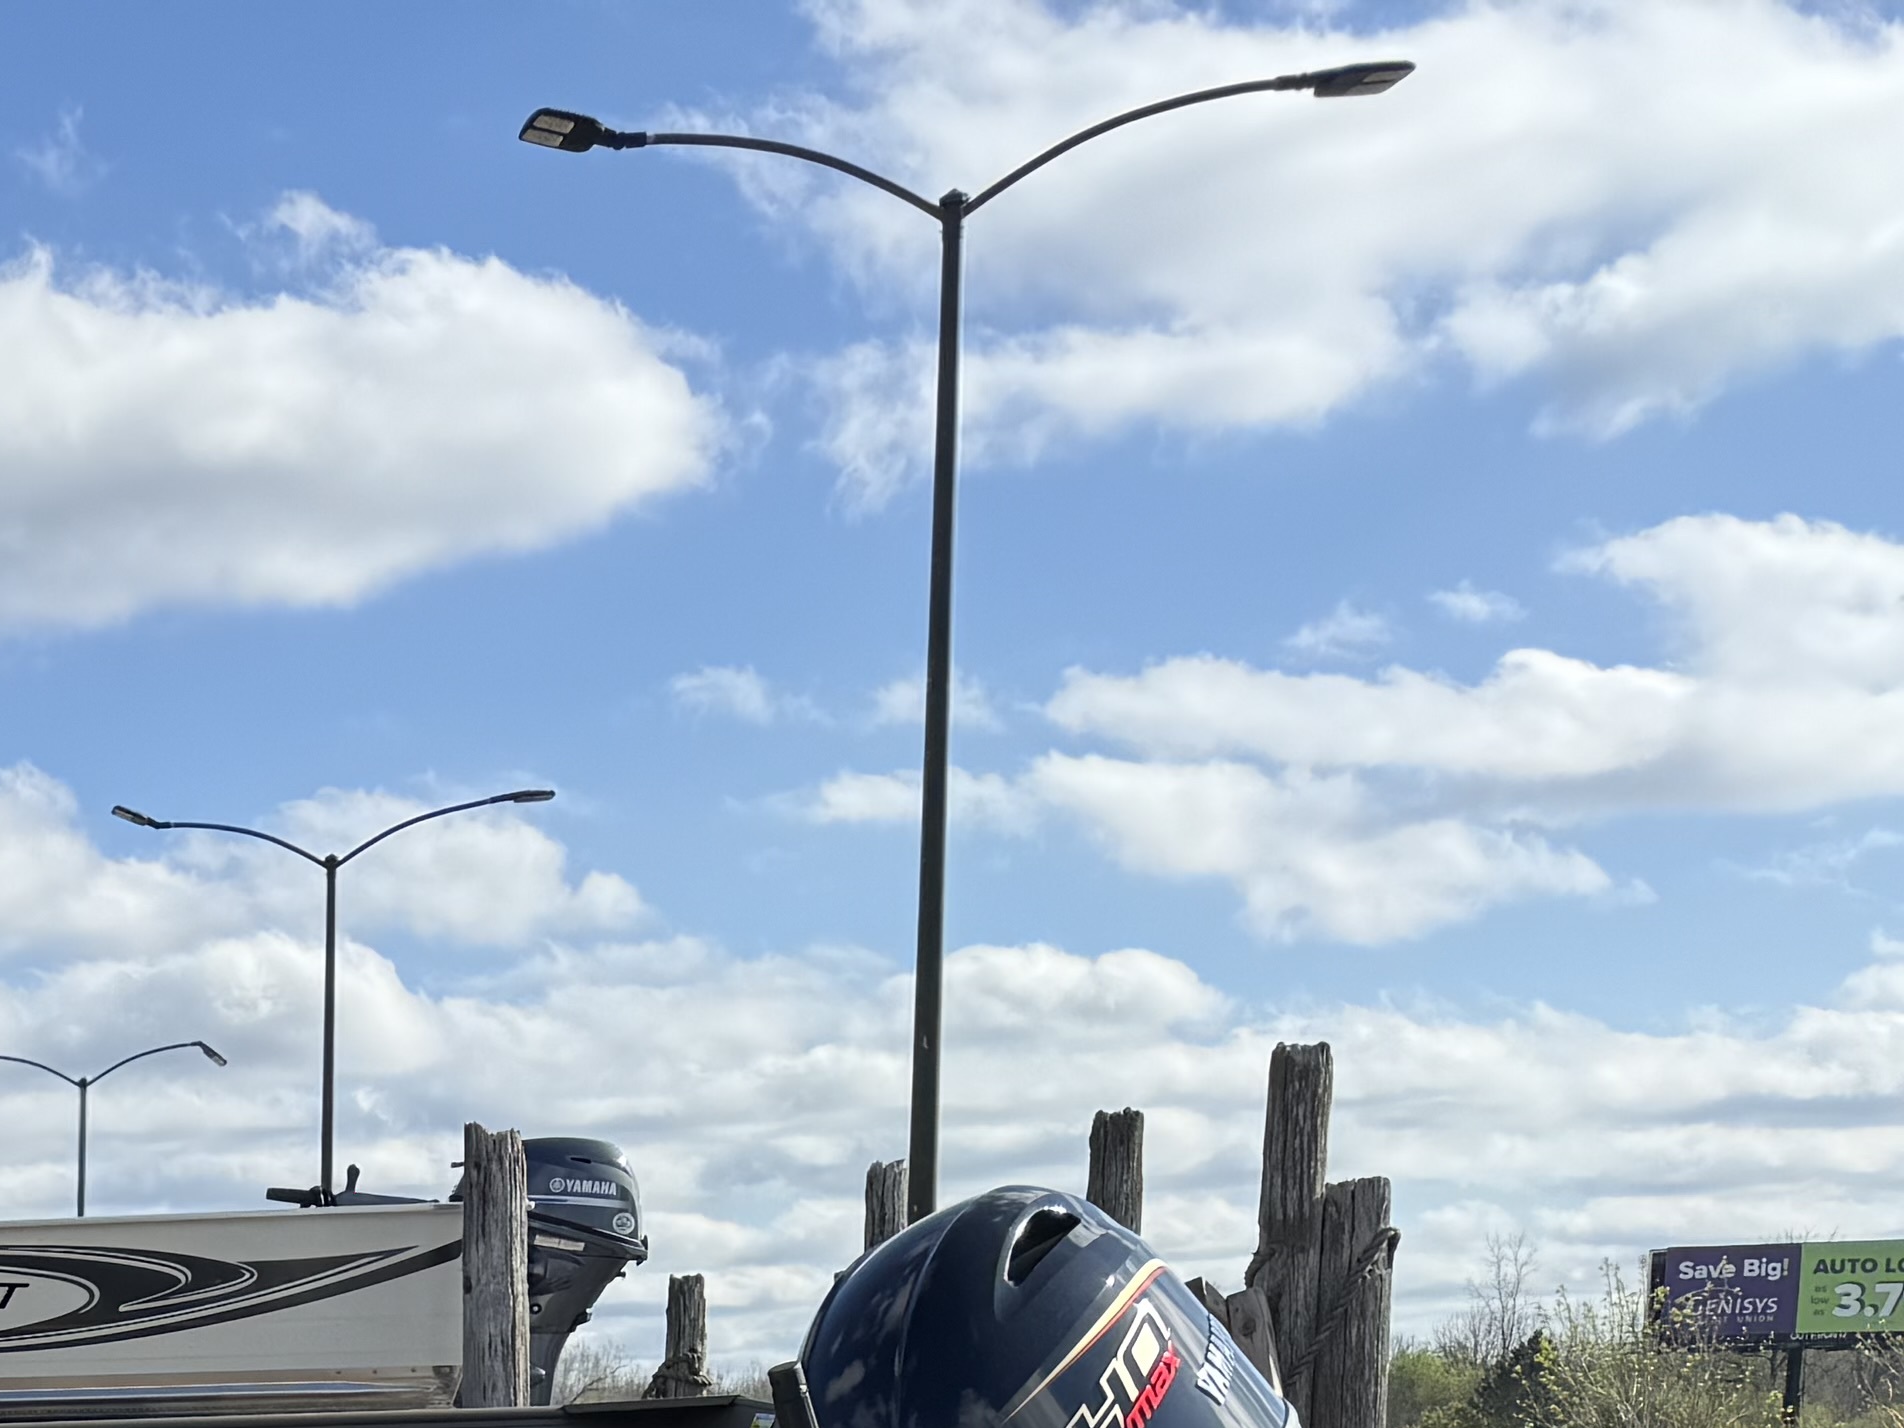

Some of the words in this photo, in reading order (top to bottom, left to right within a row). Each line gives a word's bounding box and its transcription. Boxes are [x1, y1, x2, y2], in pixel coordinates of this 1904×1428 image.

[566, 1179, 617, 1196] YAMAHA
[1678, 1260, 1737, 1280] Save
[1743, 1258, 1790, 1281] Big!
[1812, 1257, 1879, 1275] AUTO
[1831, 1281, 1904, 1317] 3.7
